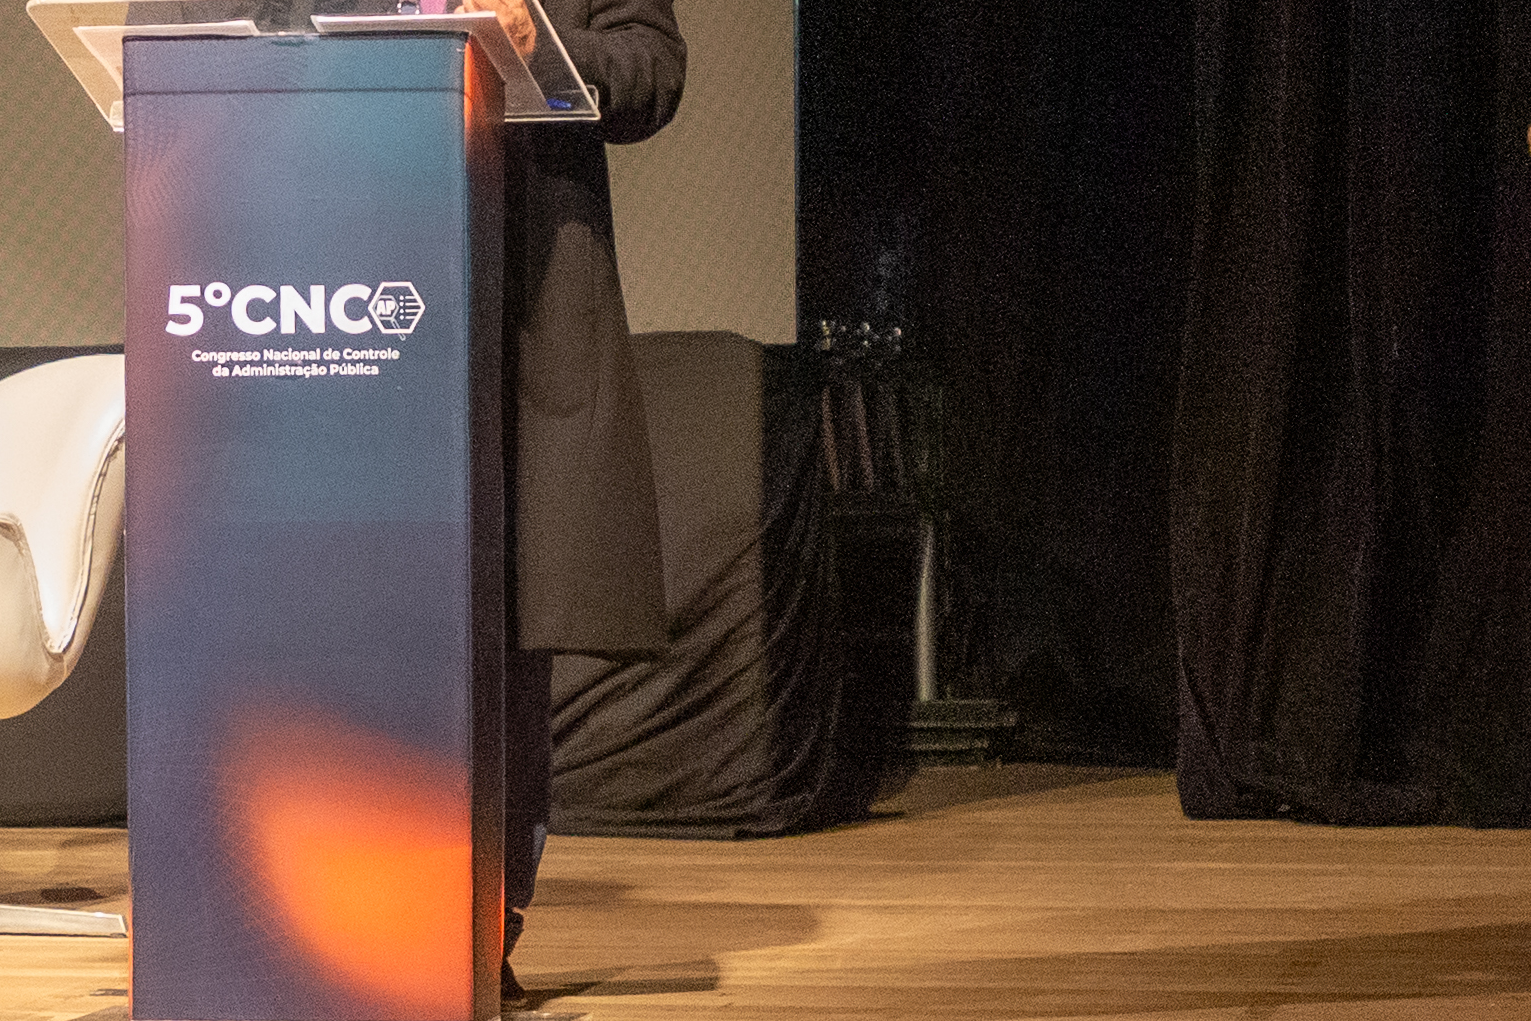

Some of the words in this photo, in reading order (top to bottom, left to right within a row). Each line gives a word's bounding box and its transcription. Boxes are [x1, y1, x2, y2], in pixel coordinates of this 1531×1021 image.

[191, 349, 261, 364] Congresso
[263, 347, 321, 361] Nacional
[323, 347, 341, 361] de
[342, 347, 400, 360] Controle
[211, 364, 230, 377] da
[231, 363, 328, 378] Administração
[330, 362, 380, 376] Pública
